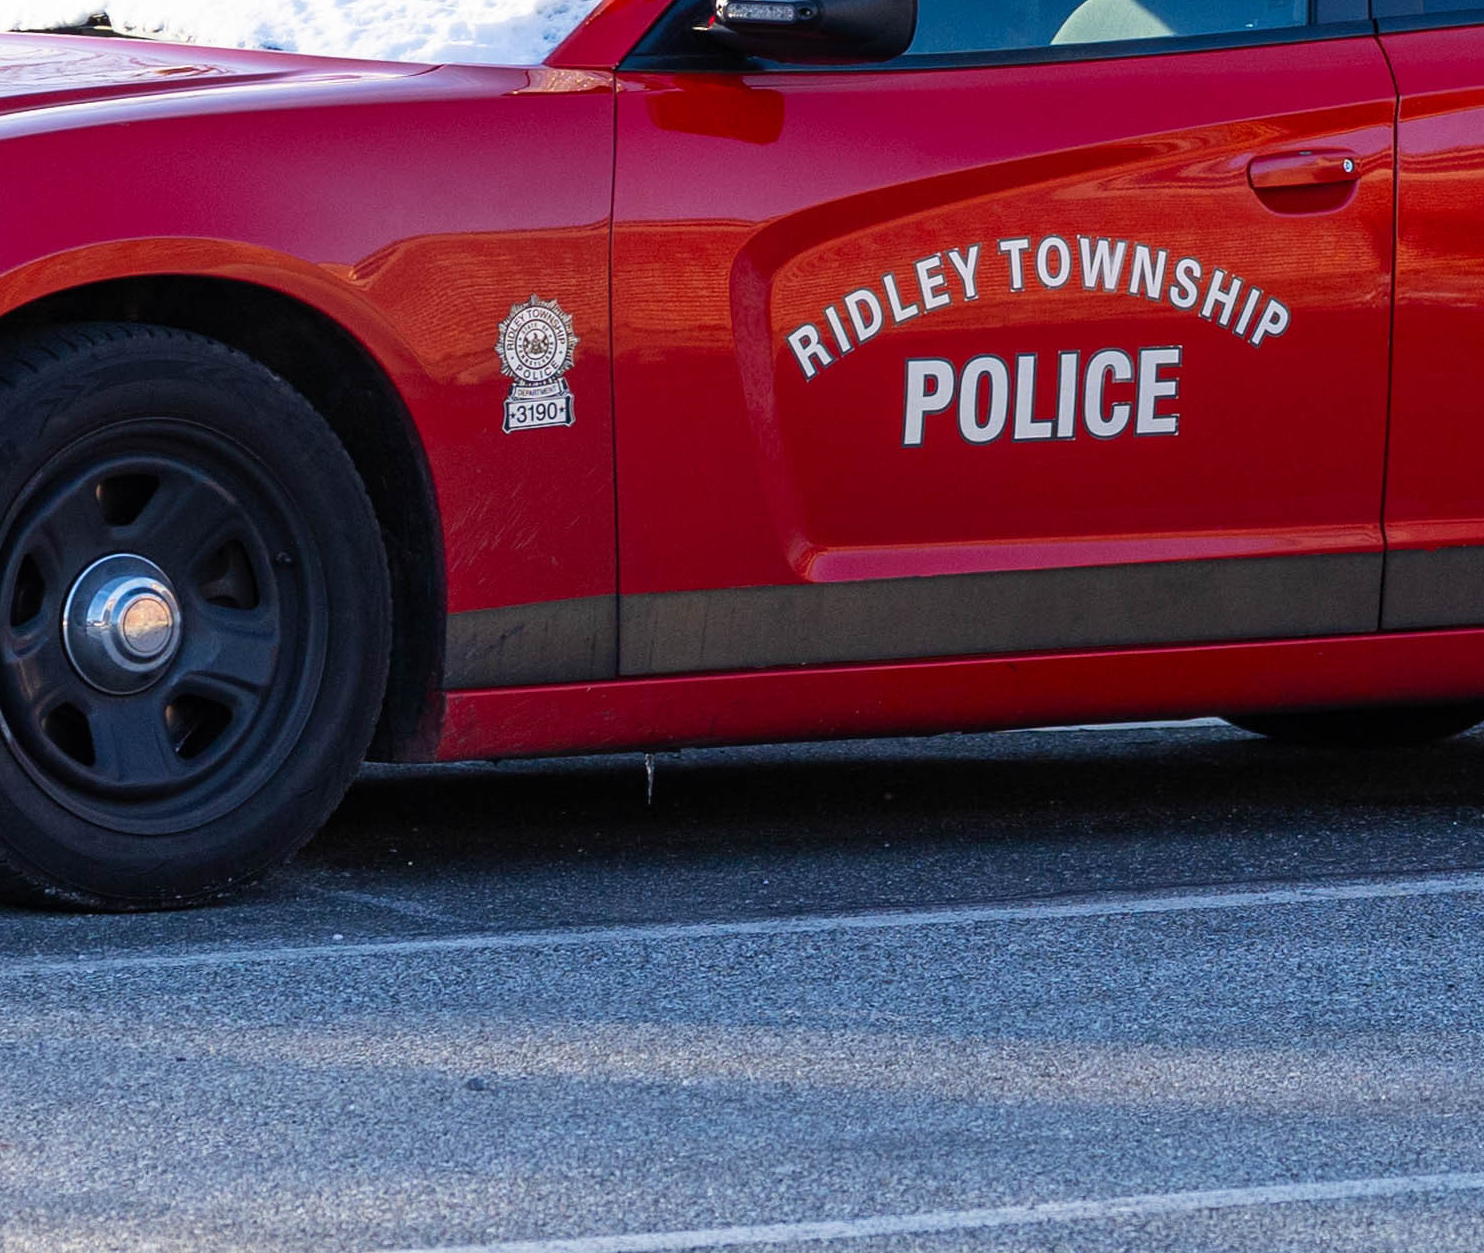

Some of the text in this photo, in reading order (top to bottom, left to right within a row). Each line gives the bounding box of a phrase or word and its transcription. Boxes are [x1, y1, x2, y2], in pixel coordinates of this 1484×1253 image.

[786, 234, 1291, 382] RIDLEY TOWNSHIP
[507, 309, 566, 351] RIDLEY TOWNSHIP
[515, 360, 560, 379] POLICE
[517, 384, 558, 397] DEPARTMENT
[901, 345, 1182, 447] POLICE
[516, 402, 557, 424] 3190
